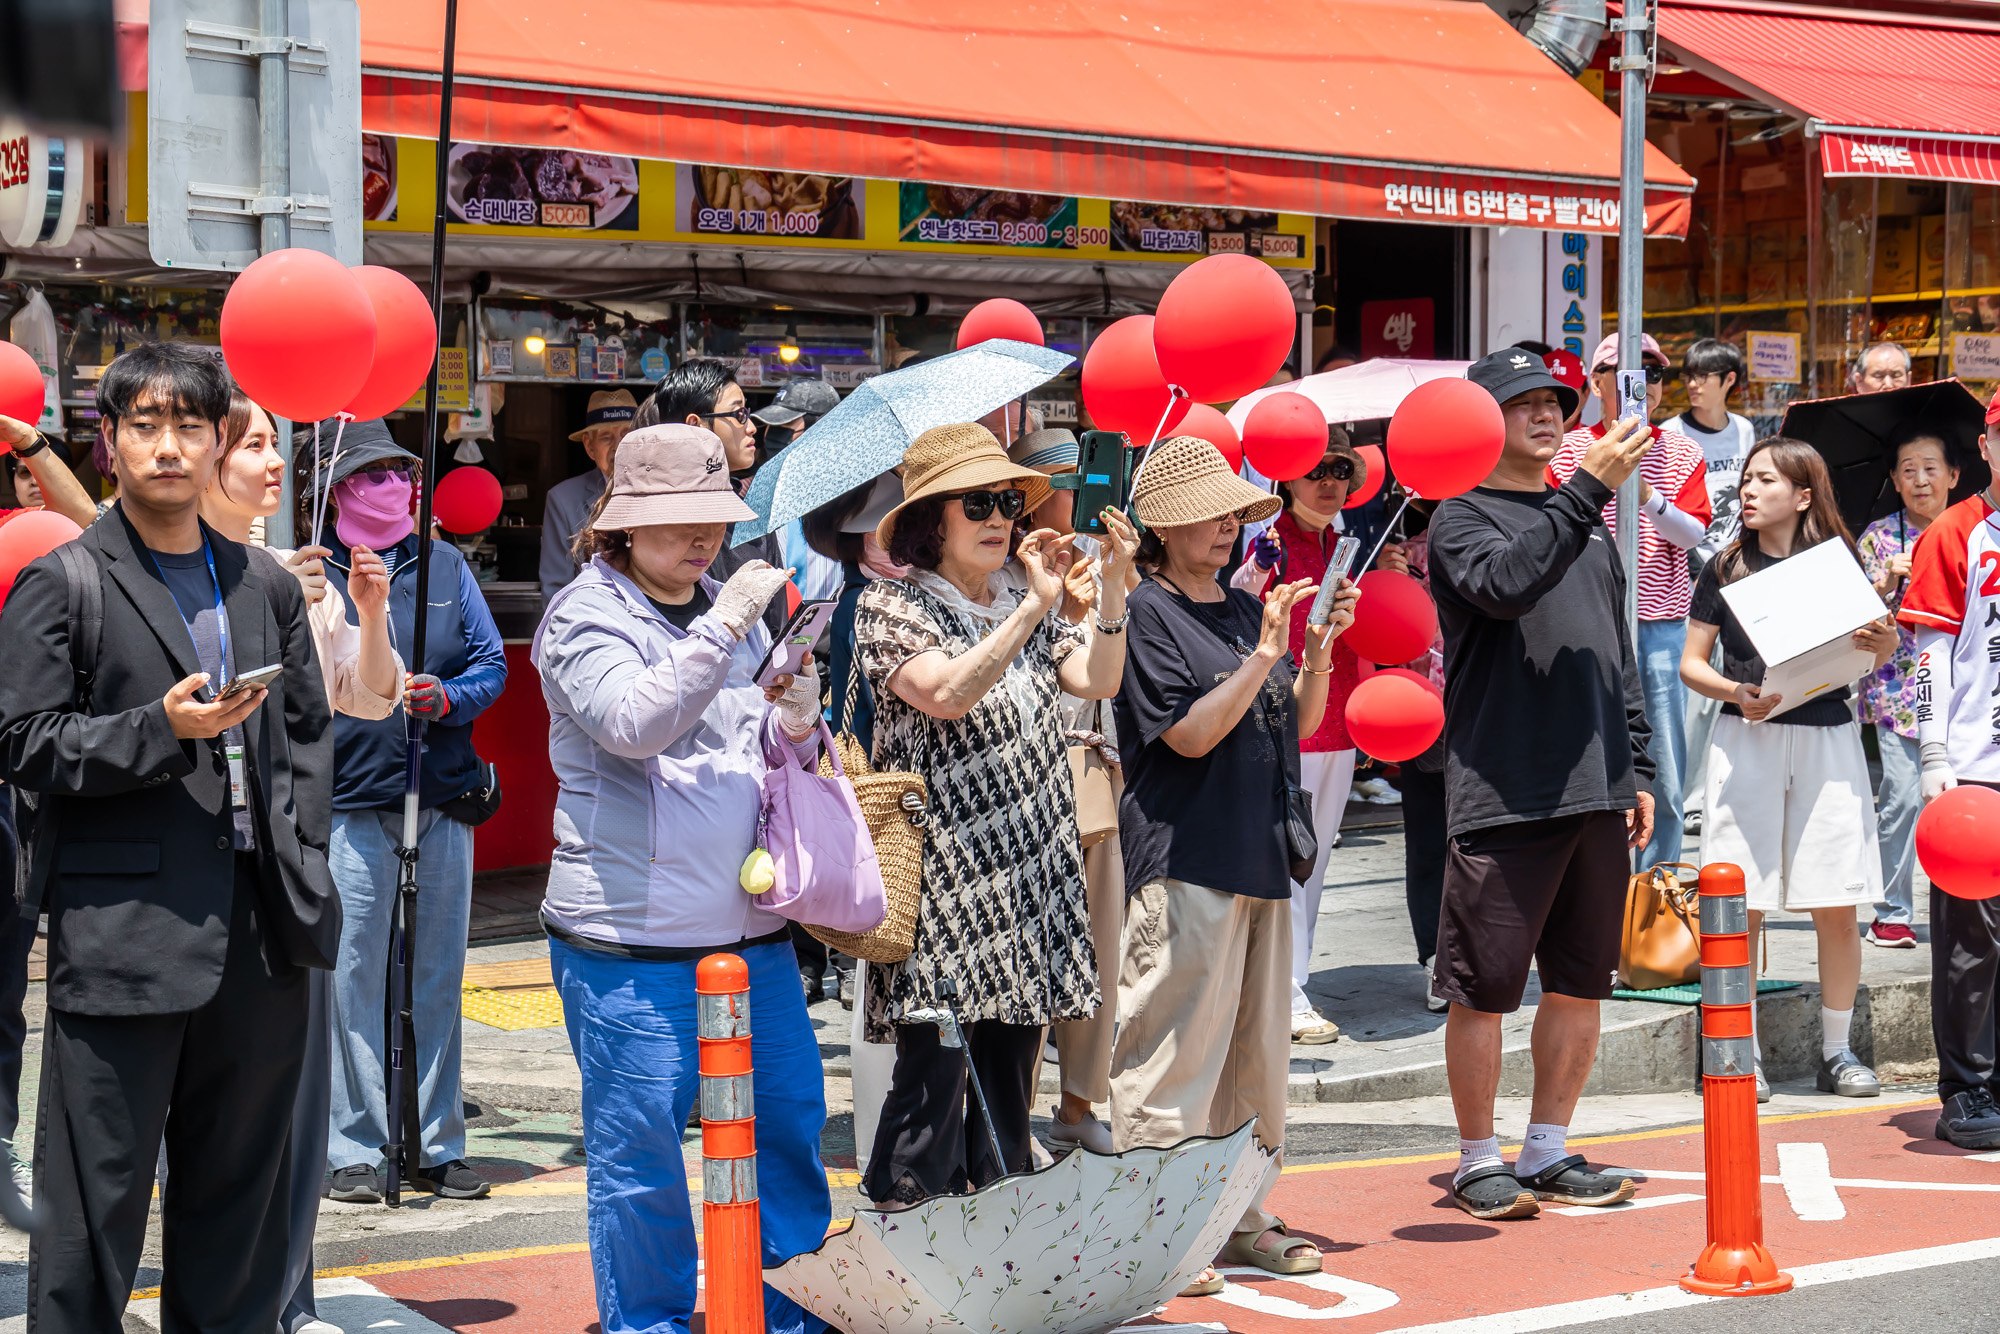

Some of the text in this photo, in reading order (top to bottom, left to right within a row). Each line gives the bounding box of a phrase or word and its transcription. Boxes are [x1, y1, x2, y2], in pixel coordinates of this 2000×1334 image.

[0, 134, 29, 191] 간오뎅
[1851, 143, 1915, 167] 스낵월드
[463, 199, 586, 224] 순대내장 5000
[1384, 183, 1458, 216] 연신내
[699, 209, 818, 234] 오뎅 1개 1,000
[919, 218, 998, 241] 옛날핫도그
[1002, 223, 1047, 243] 2,500
[1064, 225, 1109, 247] 3,500
[1142, 230, 1201, 250] 파닭꼬치
[1210, 236, 1244, 251] 3,500
[1264, 240, 1297, 254] 5,000
[439, 371, 463, 380] 0,000
[603, 409, 631, 418] BrainTop
[1919, 652, 1931, 667] 2
